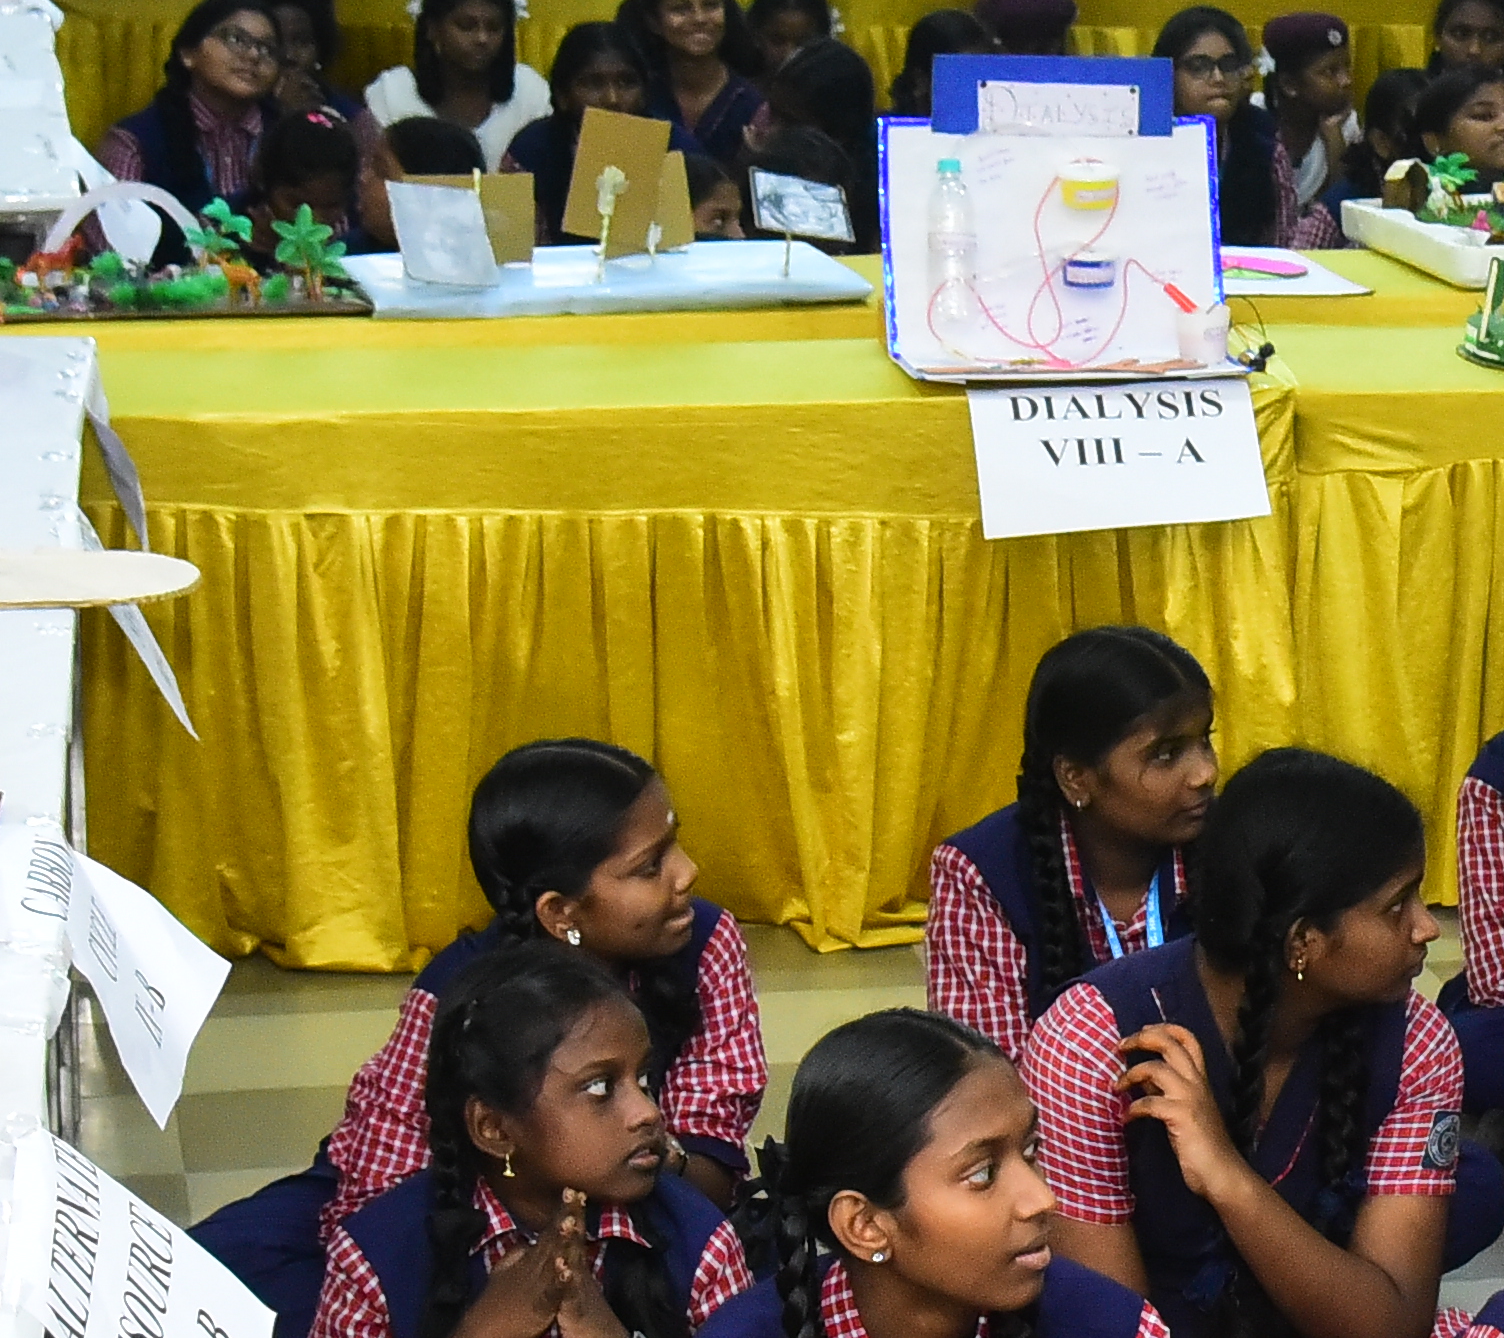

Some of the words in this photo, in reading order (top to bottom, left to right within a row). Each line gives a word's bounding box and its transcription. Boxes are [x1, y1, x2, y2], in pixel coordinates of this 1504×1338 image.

[1010, 389, 1225, 421] DIALYSIS
[1040, 437, 1125, 467] VIII
[1177, 437, 1206, 465] A
